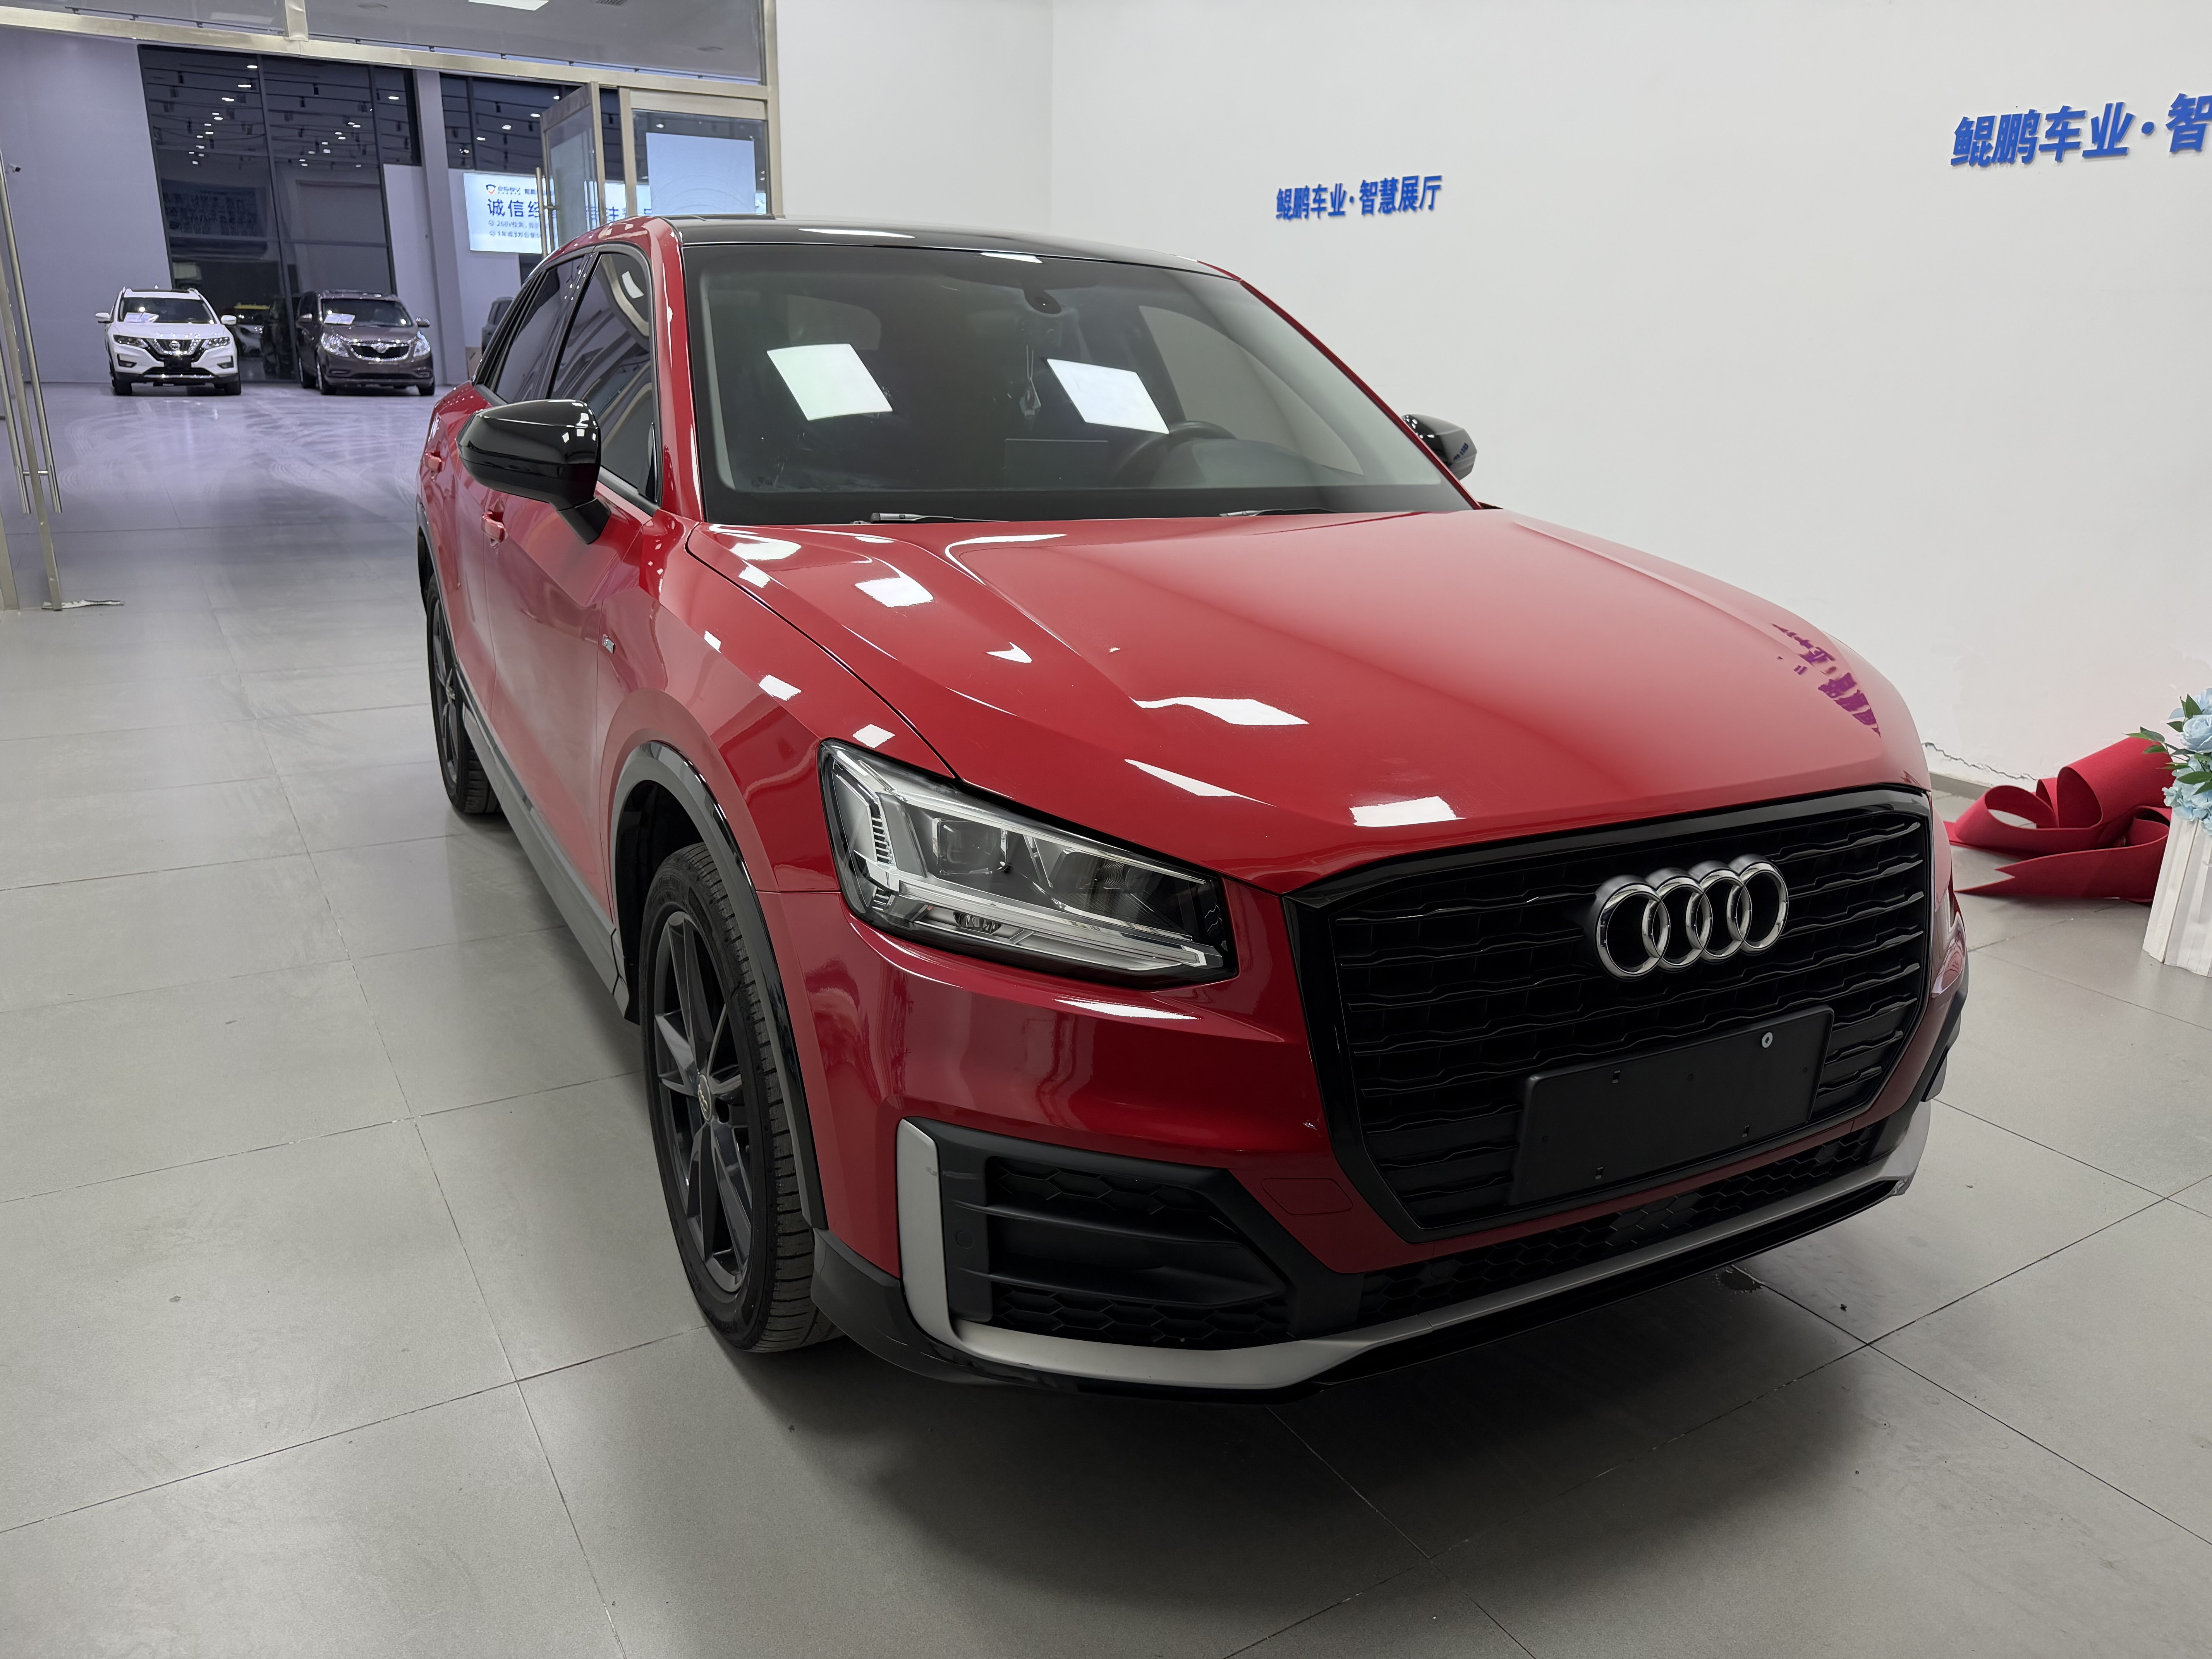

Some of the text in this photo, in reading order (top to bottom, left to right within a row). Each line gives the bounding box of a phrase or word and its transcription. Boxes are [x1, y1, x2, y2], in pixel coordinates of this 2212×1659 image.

[487, 198, 556, 218] 诚信经
[1276, 175, 1442, 220] 鲲鹏车业·智慧展厅
